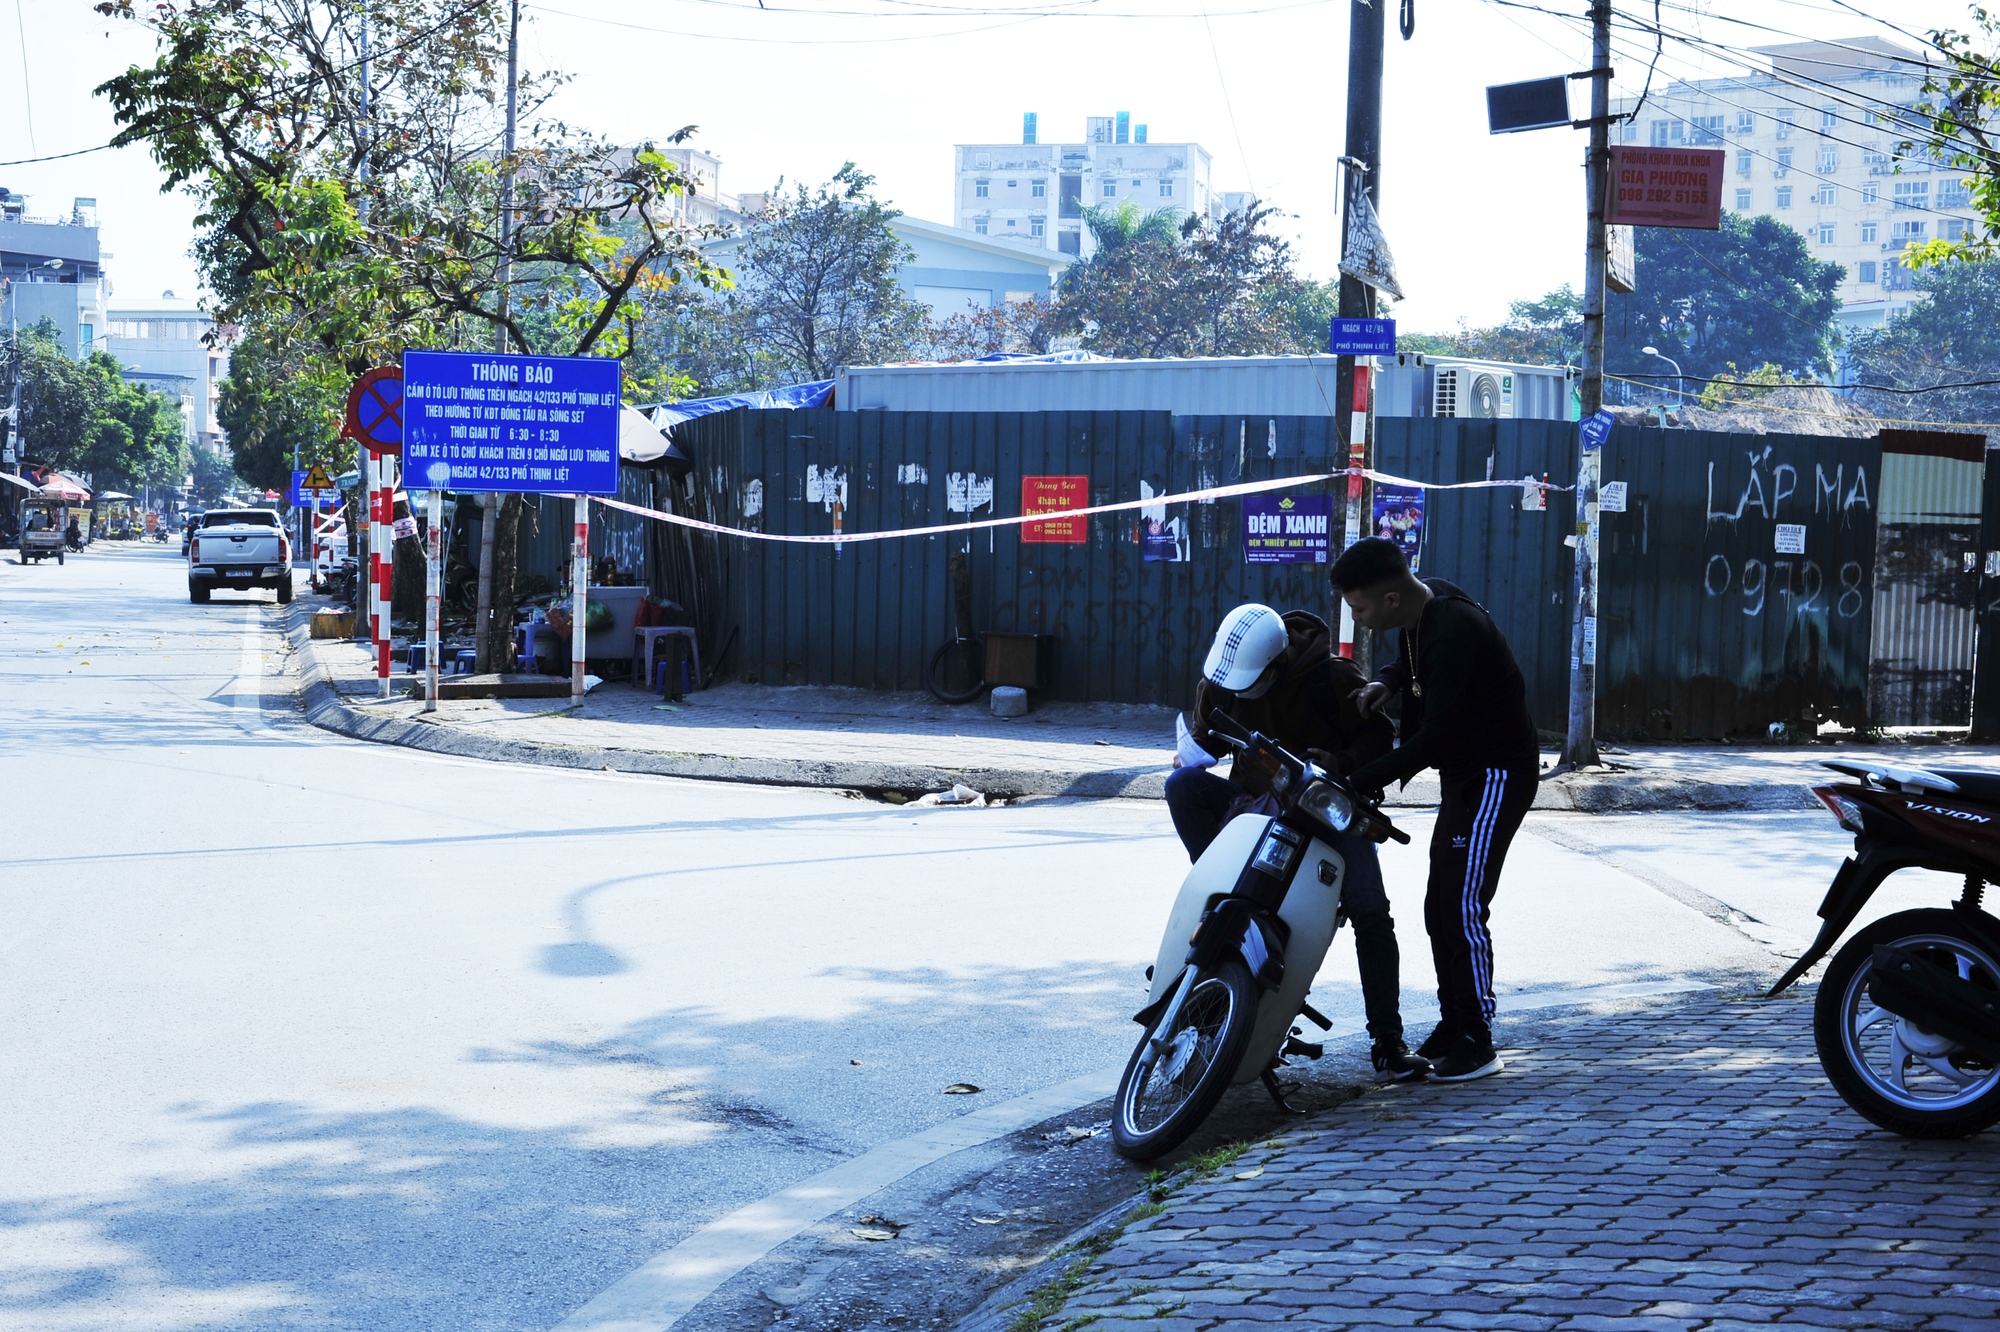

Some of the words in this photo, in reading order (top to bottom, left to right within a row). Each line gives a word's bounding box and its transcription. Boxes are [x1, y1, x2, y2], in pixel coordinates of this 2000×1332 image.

[1621, 150, 1647, 164] PHÒNG
[1649, 151, 1670, 166] KHÁM
[1672, 154, 1688, 166] NHA
[1690, 155, 1711, 168] KHOA
[1621, 169, 1644, 184] GIA
[1648, 170, 1708, 186] PHƯƠNG
[1618, 188, 1643, 202] 098
[1646, 189, 1672, 202] 292
[1675, 190, 1708, 204] 5155
[1342, 322, 1360, 333] NGÁCH
[1365, 324, 1384, 334] 42/94
[1336, 340, 1351, 350] PHỐ
[1352, 342, 1374, 352] THỊNH
[1374, 341, 1390, 352] LIỆT
[472, 360, 518, 382] THÔNG
[526, 362, 553, 384] BÁO
[406, 381, 424, 398] CẤM
[426, 383, 431, 398] Ô
[432, 384, 442, 398] TÔ
[442, 386, 458, 400] LƯU
[460, 385, 485, 400] THÔNG
[487, 386, 506, 402] TRÊN
[508, 386, 532, 403] NGÁCH
[534, 390, 560, 405] 42/133
[562, 388, 578, 404] PHỐ
[578, 392, 599, 408] THỊNH
[600, 391, 616, 408] LIỆT
[425, 404, 443, 418] THEO
[444, 403, 470, 419] HƯỚNG
[472, 404, 482, 419] TỪ
[484, 407, 499, 420] KĐT
[537, 408, 548, 422] RA
[550, 407, 570, 423] SÔNG
[572, 408, 585, 424] SÉT
[450, 423, 468, 438] THỜI
[469, 426, 488, 440] GIAN
[490, 425, 501, 440] TỪ
[510, 428, 529, 441] 6:30
[540, 429, 560, 442] 8:30
[410, 441, 428, 458] CẤM
[430, 445, 440, 458] XE
[442, 443, 448, 458] Ô
[450, 443, 460, 458] TÔ
[462, 441, 477, 458] CHỞ
[479, 444, 504, 460] KHÁCH
[507, 444, 526, 460] TRÊN
[527, 448, 532, 460] 9
[570, 448, 584, 462] LƯU
[586, 447, 610, 463] THÔNG
[452, 463, 478, 479] NGÁCH
[480, 466, 510, 480] 42/133
[512, 464, 528, 480] PHỐ
[530, 468, 552, 482] THỊNH
[554, 466, 570, 484] LIỆT
[1706, 445, 1797, 521] LẮP
[1248, 512, 1281, 538] ĐỆM
[1286, 516, 1328, 534] XANH
[1248, 538, 1260, 548] ĐỆM
[1288, 538, 1304, 547] NHẤT
[1306, 538, 1314, 547] HÀ
[1316, 538, 1327, 548] NỘI
[1905, 800, 1991, 824] VISION
[1274, 828, 1298, 842] HONDA
